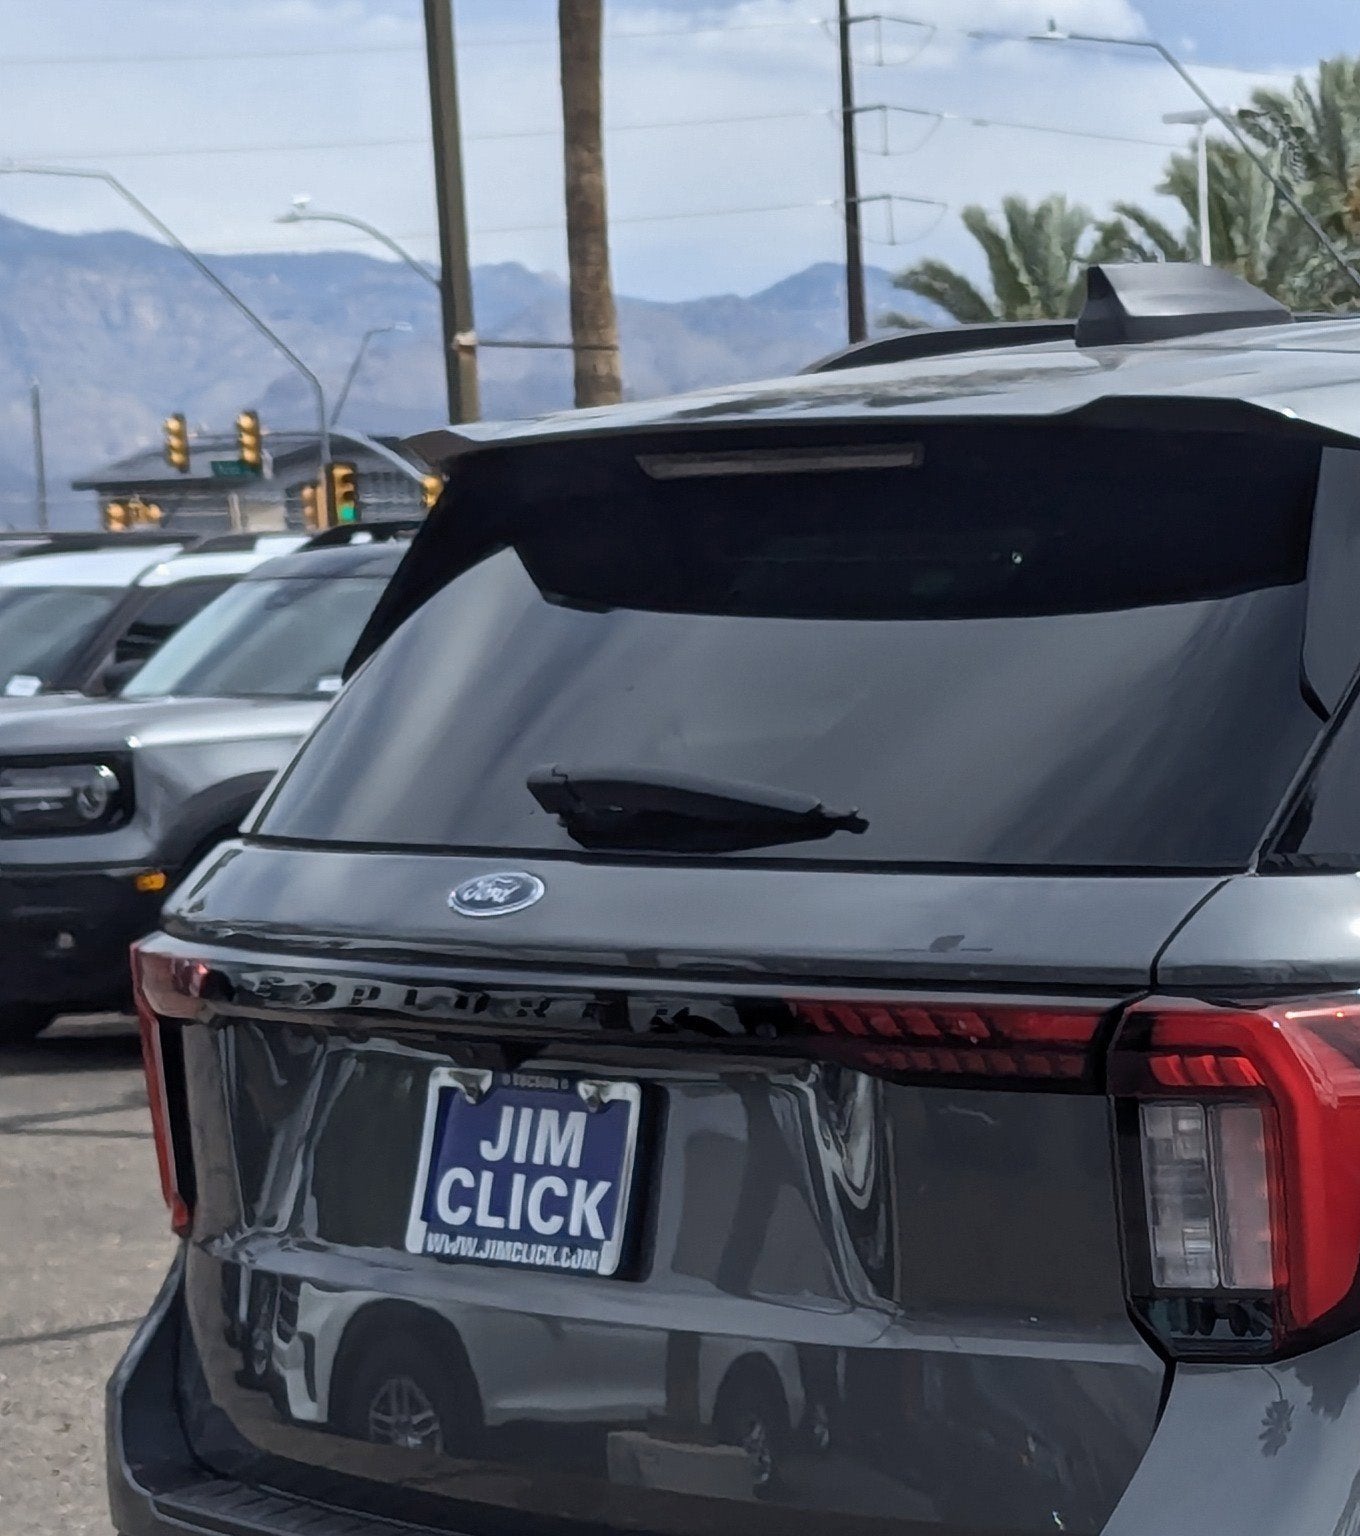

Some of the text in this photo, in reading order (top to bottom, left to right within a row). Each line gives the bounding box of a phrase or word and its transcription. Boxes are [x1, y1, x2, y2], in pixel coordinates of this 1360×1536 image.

[462, 877, 522, 903] Ford
[479, 1105, 587, 1168] JIM
[436, 1166, 612, 1240] CLICK
[426, 1231, 600, 1271] WWW.JIMCLICK.COM
